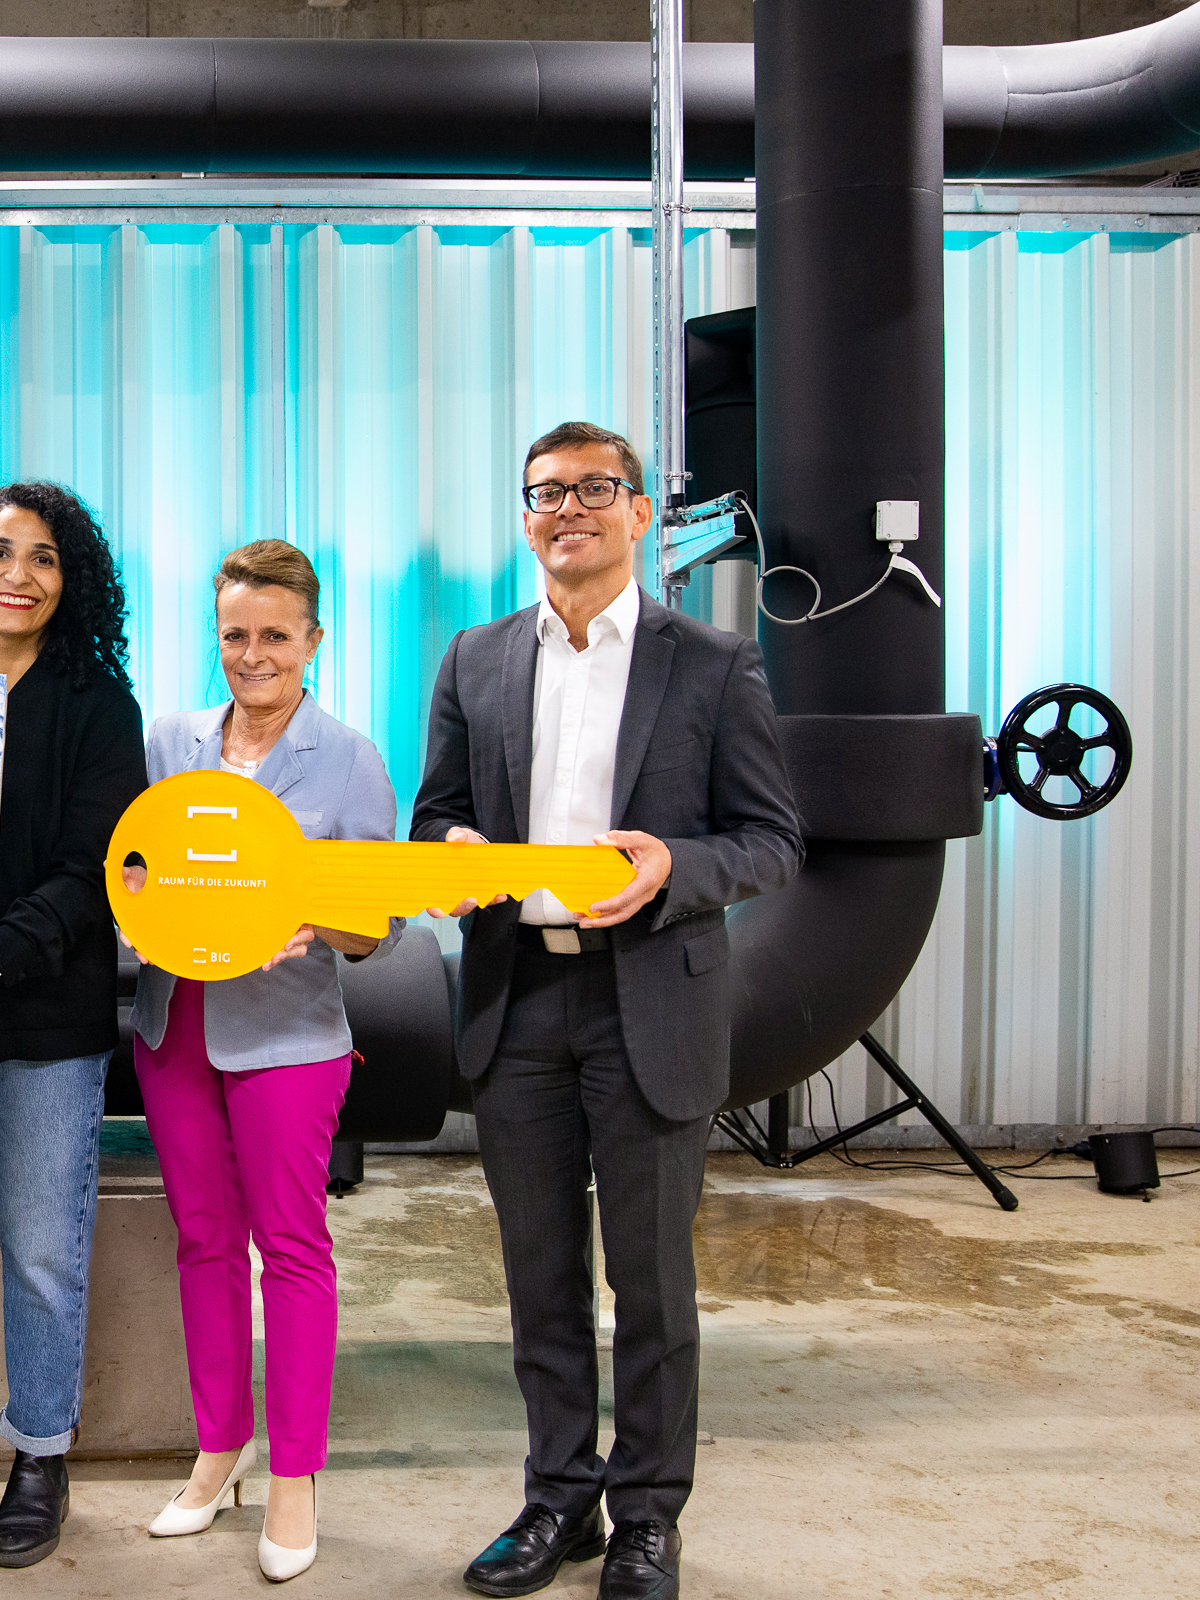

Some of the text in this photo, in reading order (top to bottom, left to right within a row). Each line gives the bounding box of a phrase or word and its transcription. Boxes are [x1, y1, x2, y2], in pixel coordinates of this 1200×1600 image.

[158, 875, 267, 888] RAUM FÜR DIE ZUKUNFT
[210, 952, 231, 963] BIG
